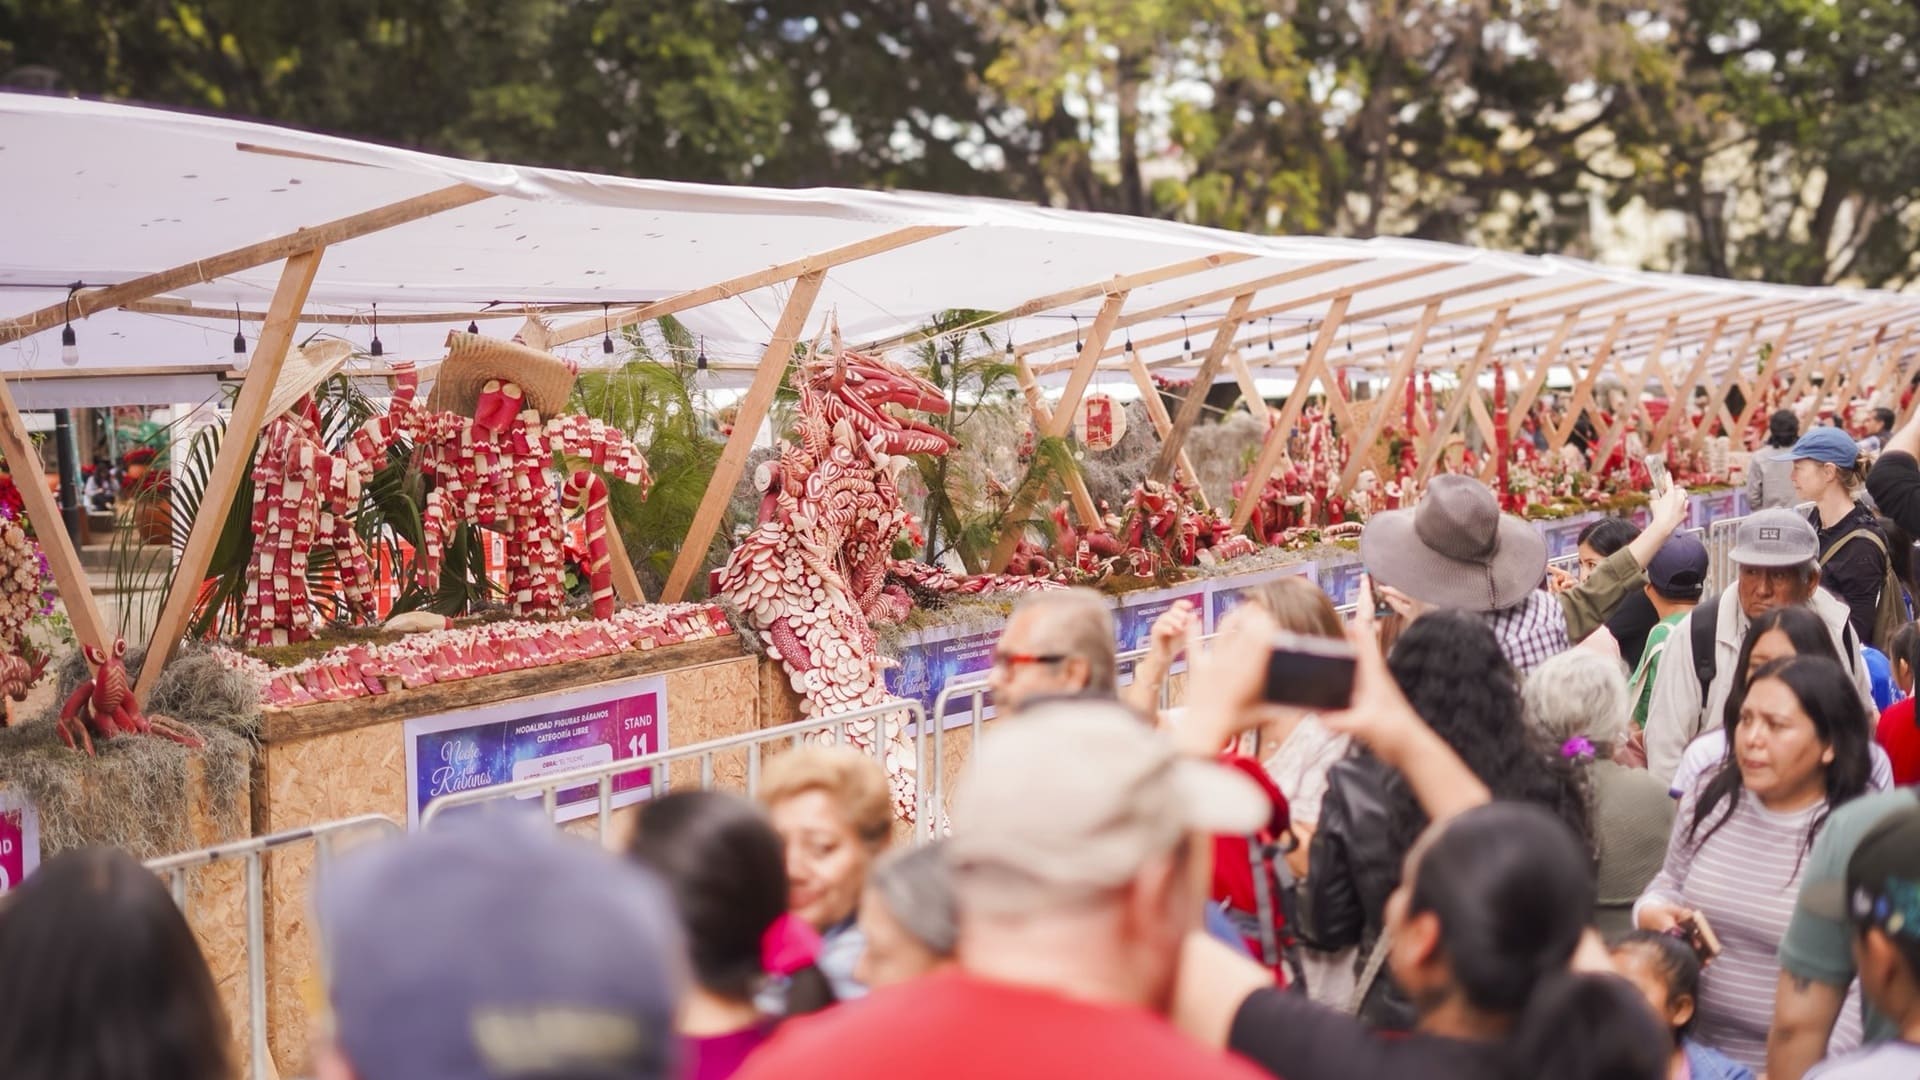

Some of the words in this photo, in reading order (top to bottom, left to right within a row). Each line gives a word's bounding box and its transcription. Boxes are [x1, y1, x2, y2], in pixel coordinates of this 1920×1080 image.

[515, 720, 553, 735] MODALIDAD
[554, 715, 581, 728] FIGURAS
[581, 709, 609, 722] RÁBANOS
[536, 728, 571, 744] CATEGORÍA
[572, 725, 589, 737] LIBRE
[624, 714, 653, 730] STAND
[441, 740, 481, 767] Noche
[629, 733, 647, 759] 11
[430, 765, 493, 797] Rábanos
